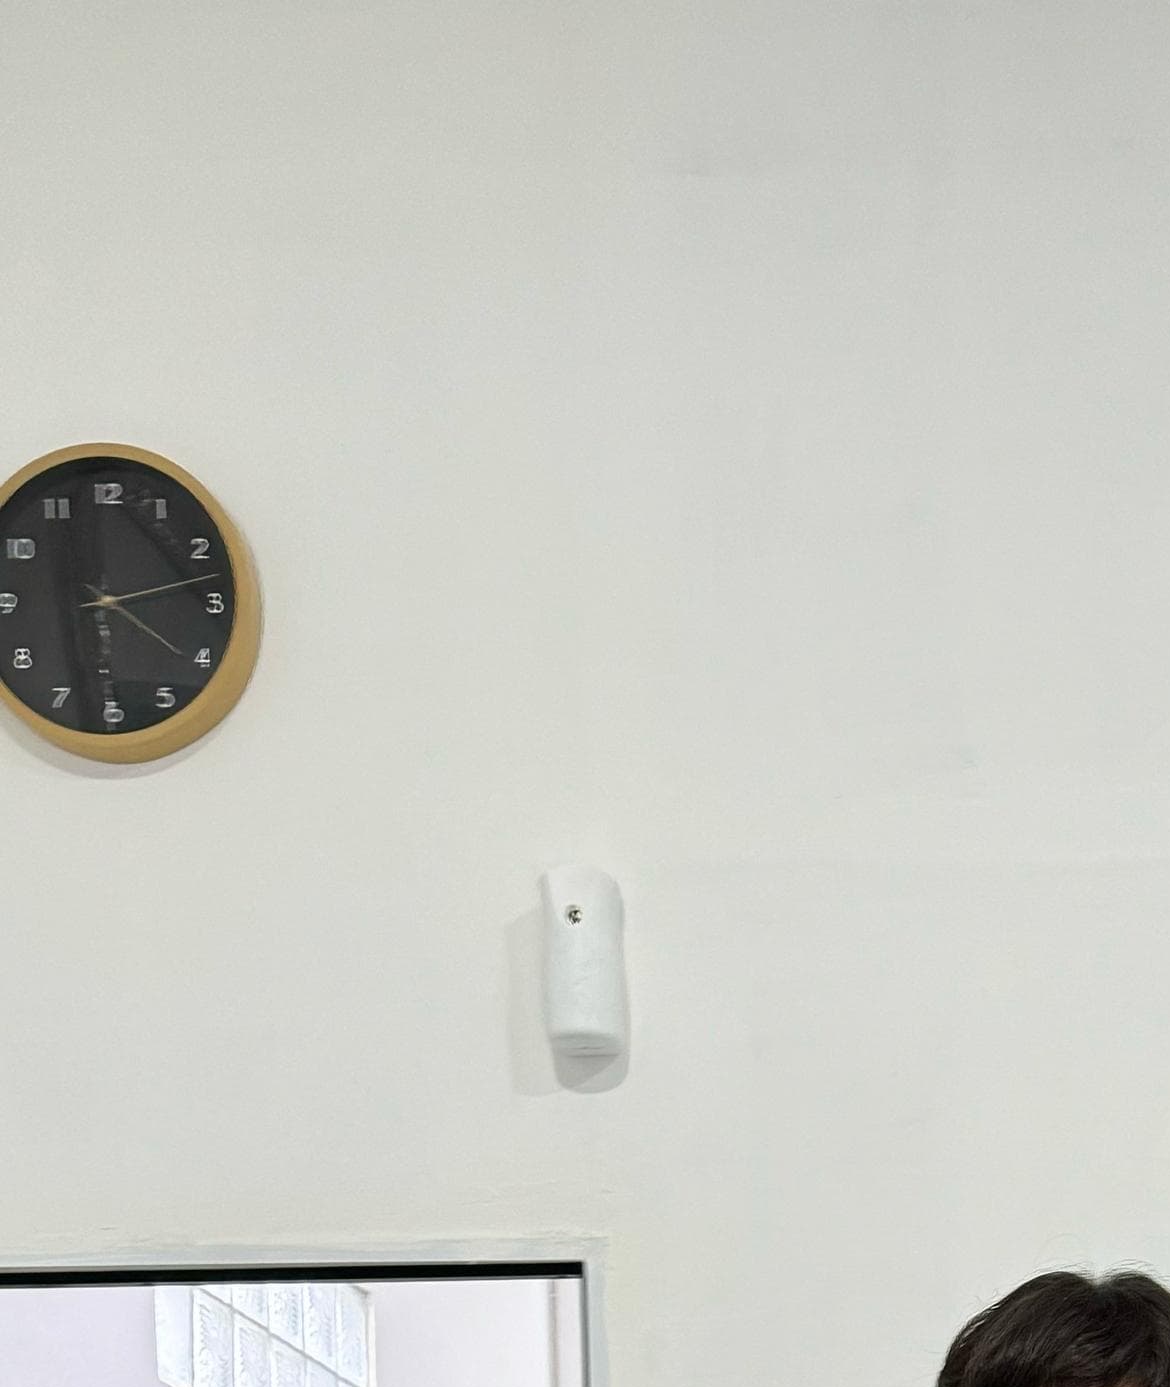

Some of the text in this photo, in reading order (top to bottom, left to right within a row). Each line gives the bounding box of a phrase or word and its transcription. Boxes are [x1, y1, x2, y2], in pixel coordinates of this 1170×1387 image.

[44, 498, 71, 519] 11
[156, 498, 168, 519] 1
[190, 538, 210, 559] 2
[0, 593, 18, 614] 9
[206, 593, 225, 614] 3
[13, 648, 33, 669] 8
[194, 648, 211, 668] 4
[51, 687, 72, 708] 7
[156, 687, 176, 708] 5
[103, 701, 125, 723] 6
